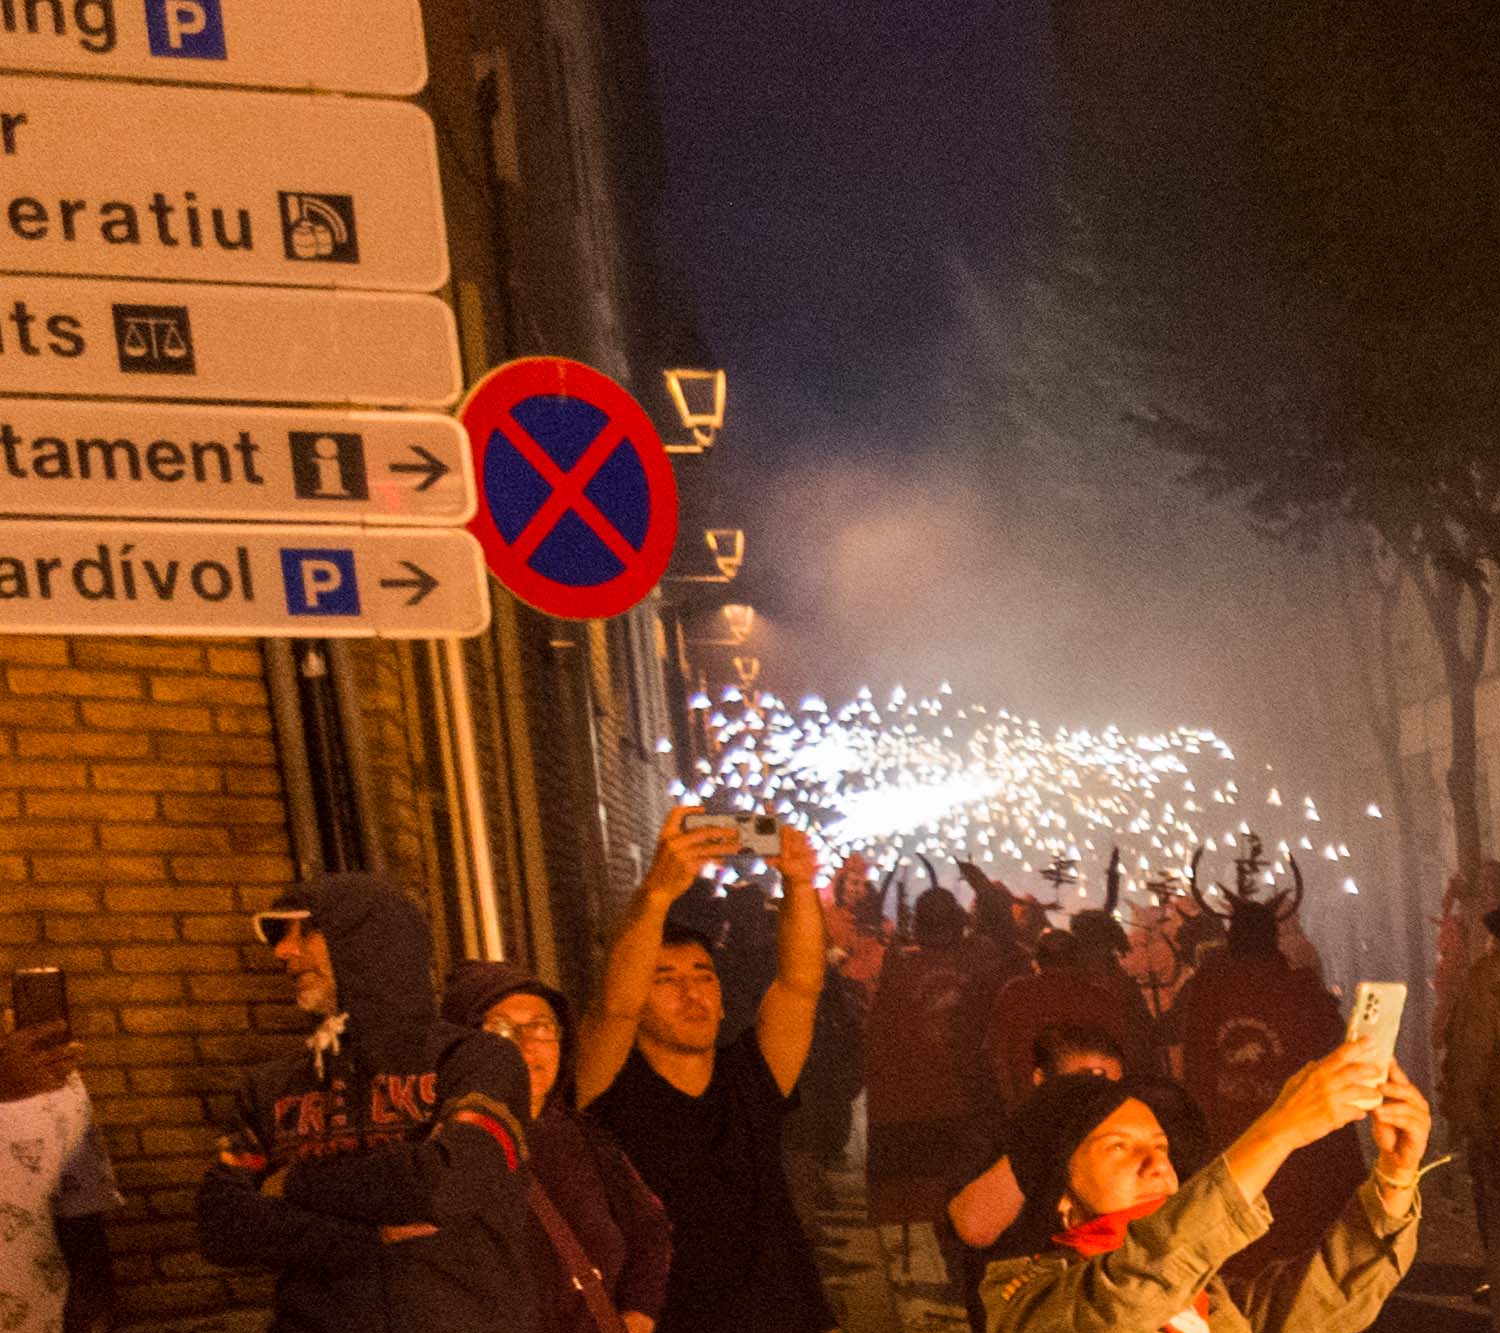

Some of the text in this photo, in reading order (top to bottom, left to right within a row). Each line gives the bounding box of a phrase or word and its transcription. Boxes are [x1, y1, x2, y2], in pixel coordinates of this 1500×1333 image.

[7, 189, 254, 251] eratiu
[0, 300, 86, 358] ts
[0, 424, 264, 485] tament
[0, 543, 254, 602] ardívol
